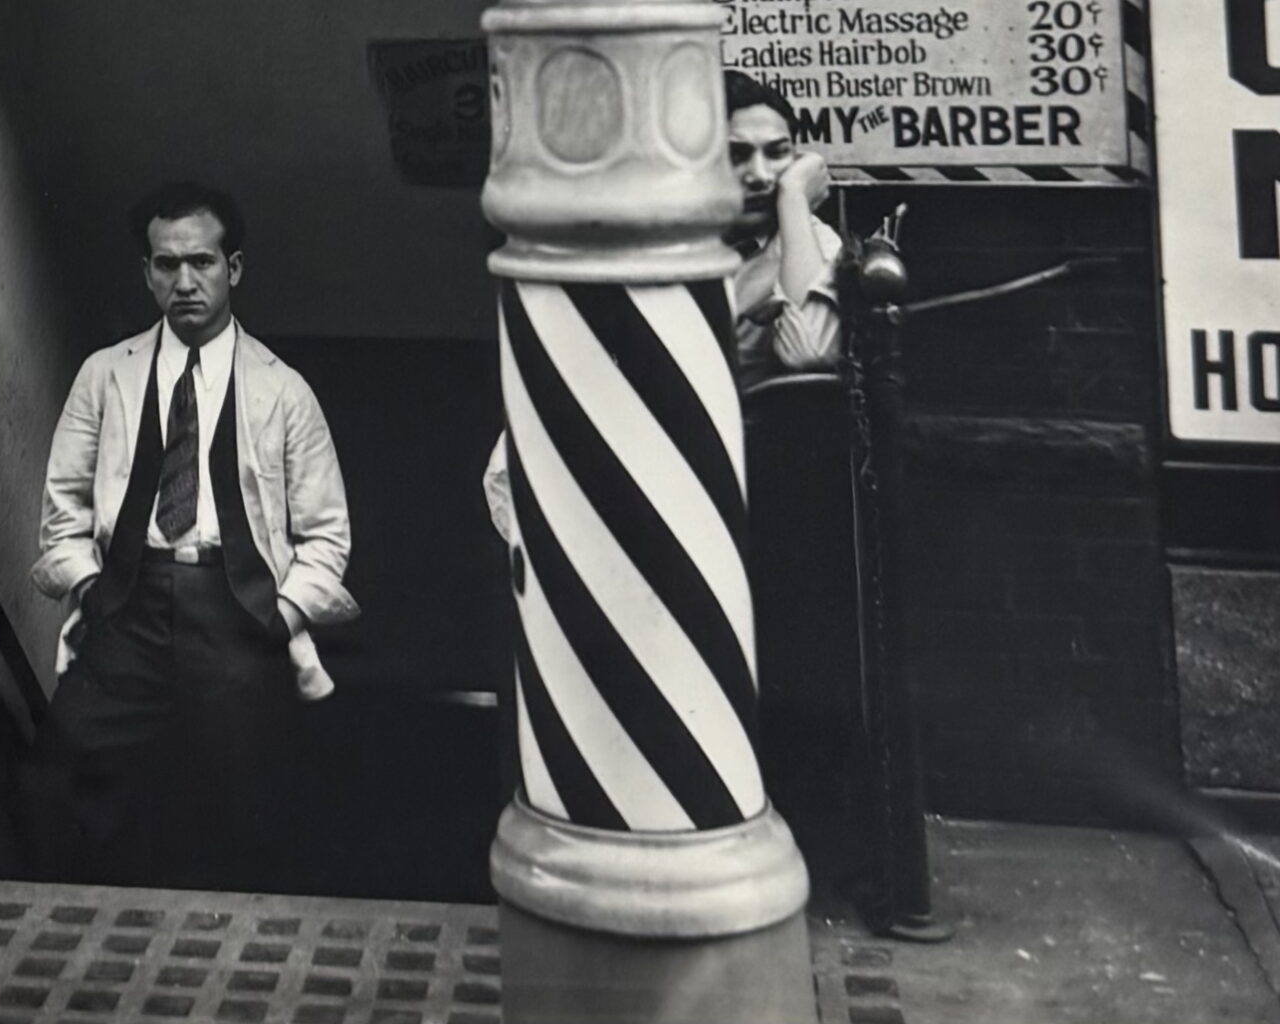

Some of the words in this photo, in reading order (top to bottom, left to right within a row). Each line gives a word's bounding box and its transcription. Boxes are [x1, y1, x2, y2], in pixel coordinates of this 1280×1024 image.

[721, 7, 831, 36] Electric
[838, 7, 969, 39] Massage
[721, 40, 811, 67] Ladies
[818, 39, 926, 65] Hairbob
[827, 74, 907, 97] Buster
[913, 73, 991, 97] Brown
[858, 105, 890, 135] THE
[892, 105, 1082, 149] BARBER
